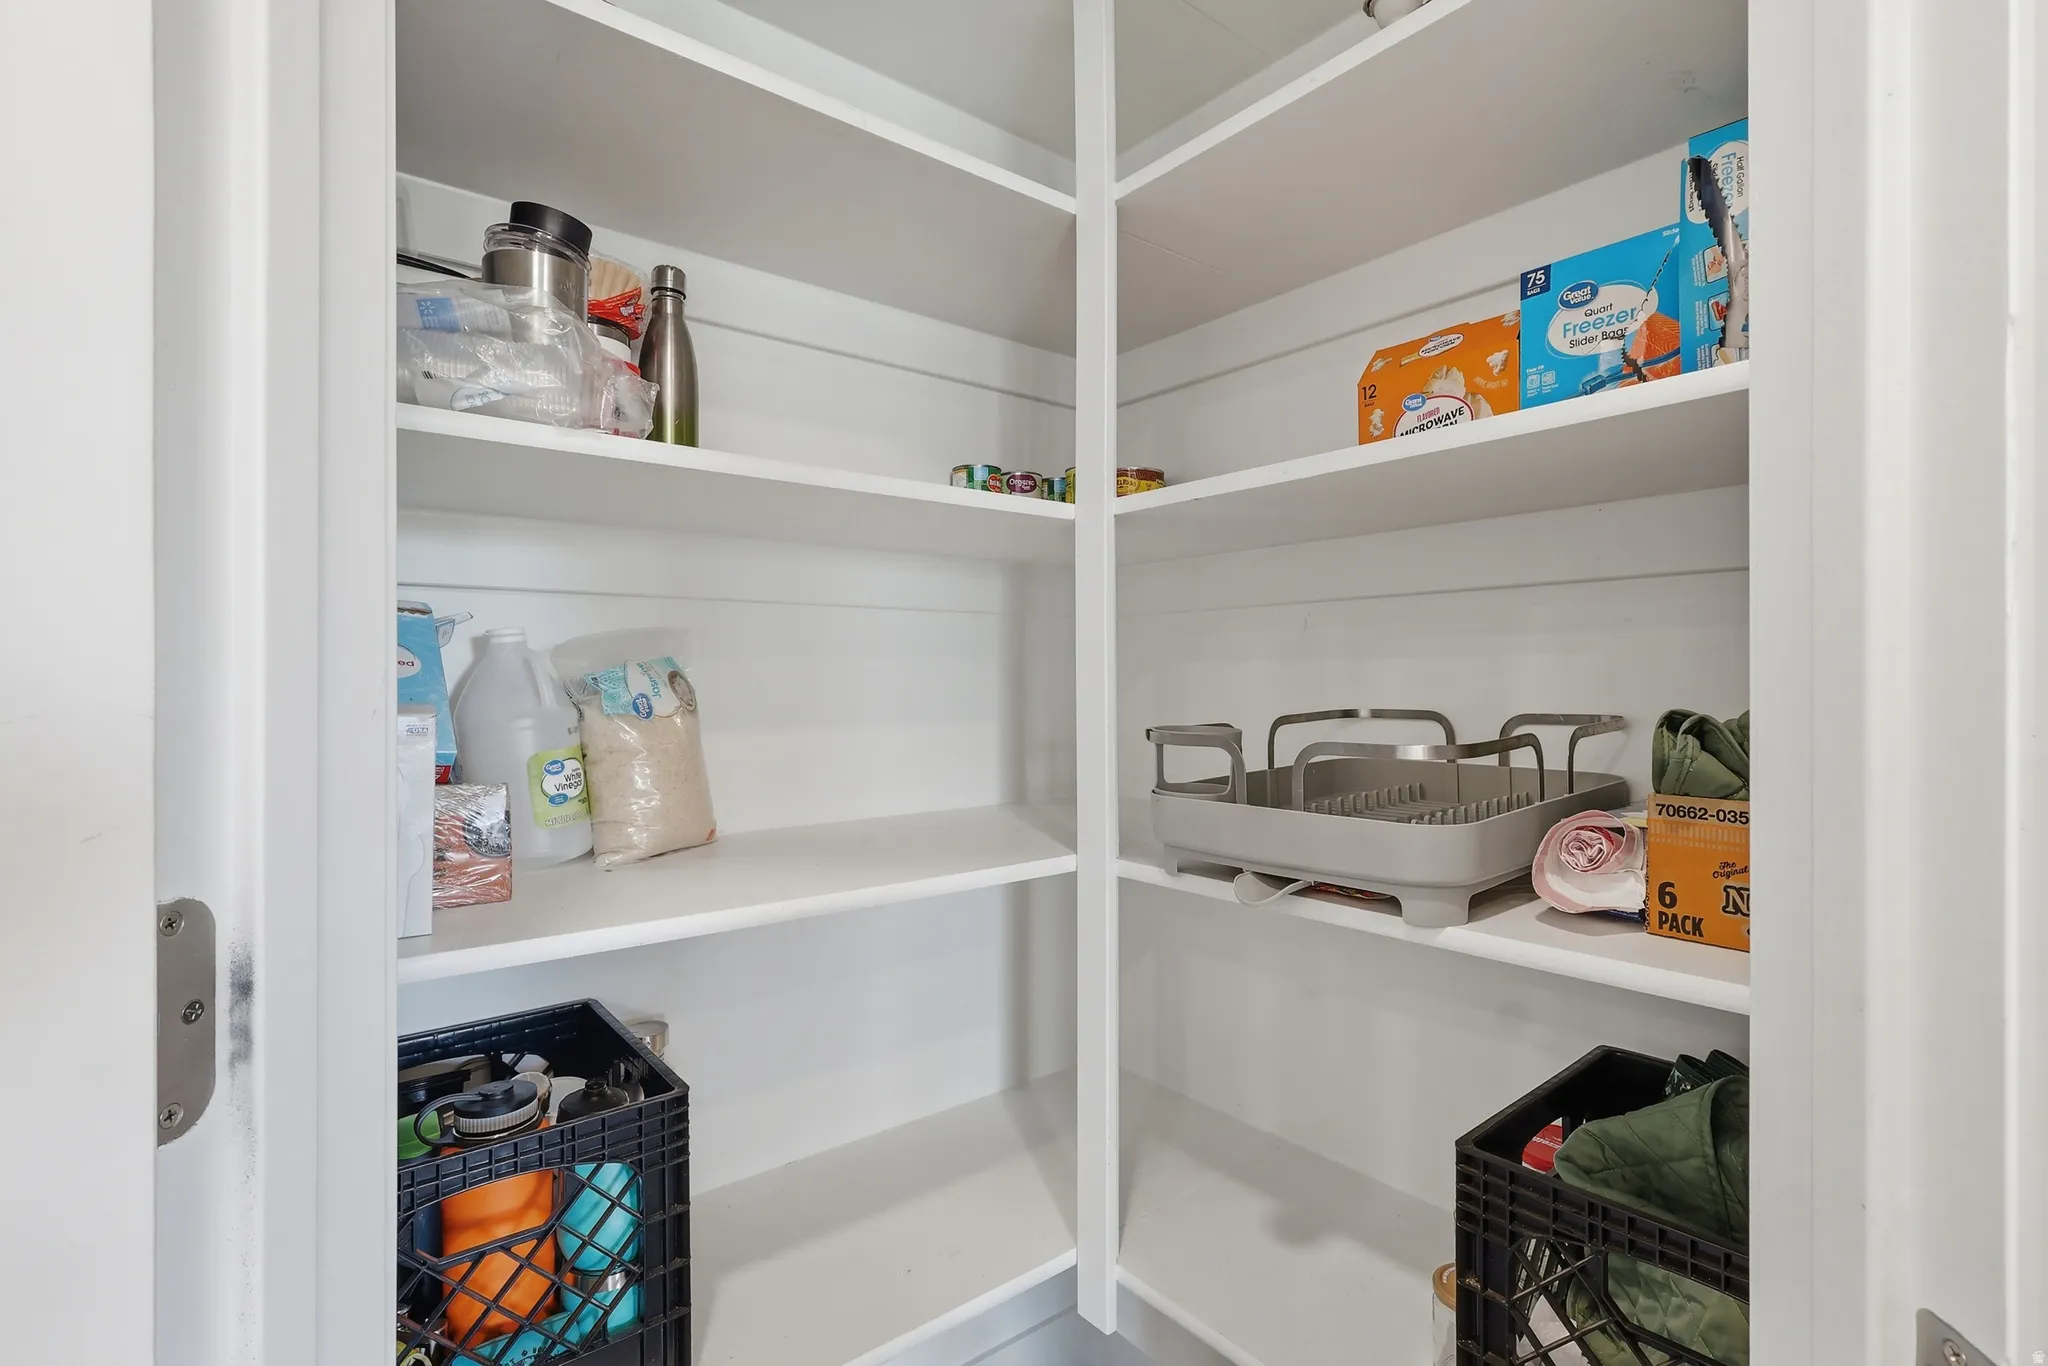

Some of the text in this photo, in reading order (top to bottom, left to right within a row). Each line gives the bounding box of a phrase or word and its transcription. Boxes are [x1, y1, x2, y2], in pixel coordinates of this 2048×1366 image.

[1737, 172, 1745, 198] Gallon
[1527, 270, 1545, 288] 75
[1563, 285, 1592, 301] Great
[1569, 294, 1593, 304] Value
[1584, 303, 1613, 317] Quart
[1563, 307, 1637, 339] Freezer
[1569, 326, 1629, 349] Slider Bags
[1362, 384, 1377, 401] 12
[1009, 478, 1035, 487] Organic
[636, 662, 662, 699] Jasmine
[554, 779, 583, 792] Vinegar
[563, 772, 582, 782] White
[1655, 803, 1749, 825] 70662-035
[1712, 865, 1749, 879] Original
[1718, 861, 1737, 871] The
[1657, 881, 1678, 909] 6
[1658, 910, 1704, 938] PACK
